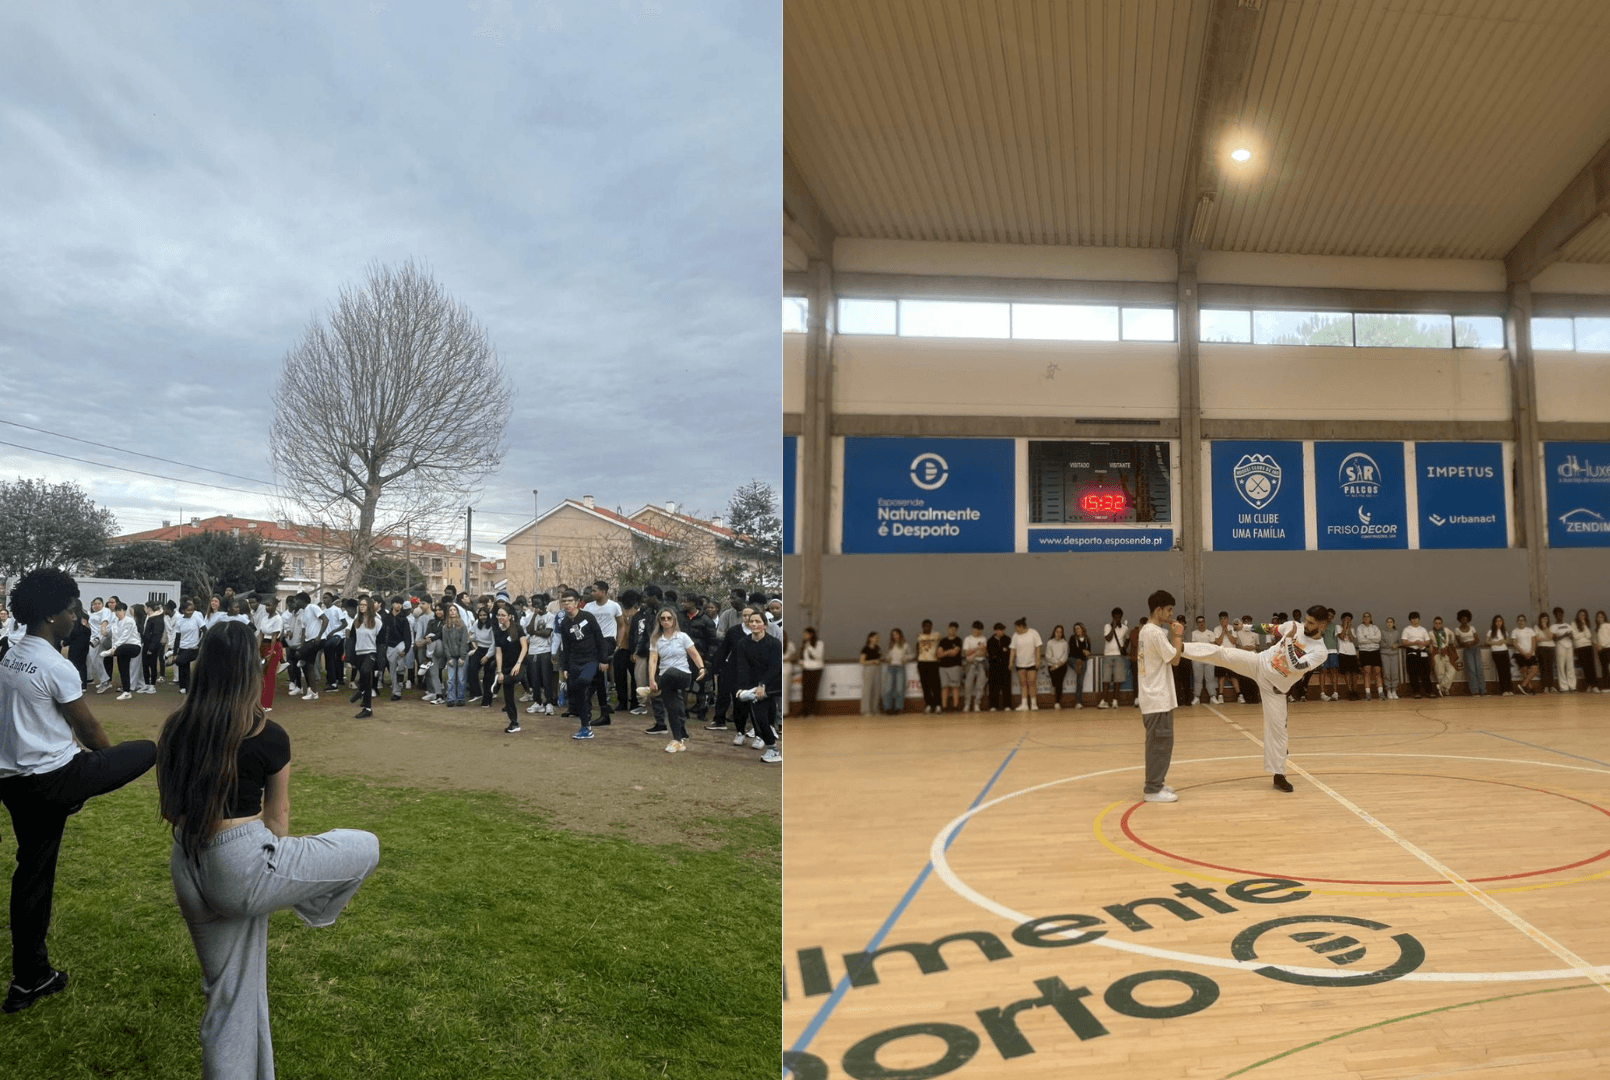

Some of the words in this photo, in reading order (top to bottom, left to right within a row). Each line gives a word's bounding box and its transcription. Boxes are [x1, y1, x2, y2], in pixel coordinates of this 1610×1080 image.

[1427, 466, 1494, 478] IMPETUS
[1344, 485, 1378, 494] PALCOS
[1084, 494, 1125, 510] 15:32
[878, 507, 981, 521] Naturalmente
[1238, 513, 1252, 524] UM
[1253, 513, 1279, 524] CLUBE
[1449, 515, 1496, 524] Urbanact
[878, 521, 889, 536] é
[892, 523, 960, 539] Desporto
[1232, 528, 1251, 539] UMA
[1253, 526, 1286, 539] FAMÍLIA
[1039, 536, 1162, 547] www.desporto.esposende.pt
[783, 878, 1312, 1001] lmente
